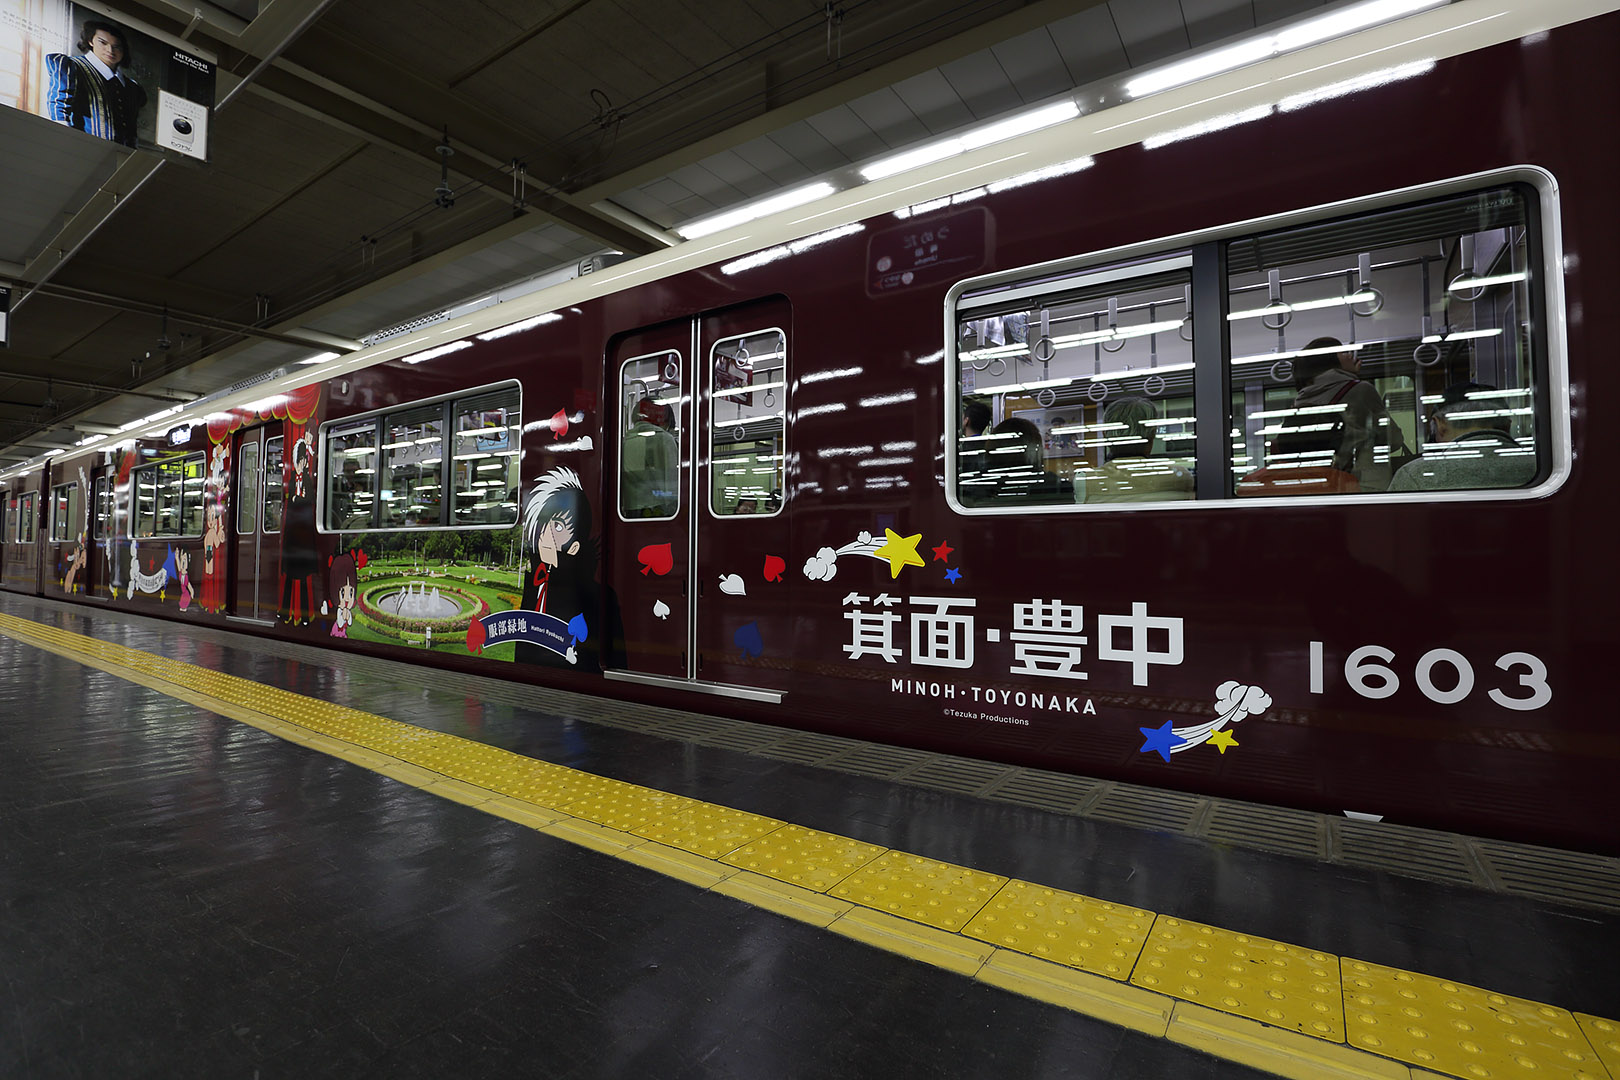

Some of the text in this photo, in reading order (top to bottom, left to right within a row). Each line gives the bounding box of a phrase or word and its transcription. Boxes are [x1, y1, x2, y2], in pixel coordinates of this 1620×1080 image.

[175, 51, 208, 70] HITACHI
[487, 618, 528, 639] 服部緑地
[842, 592, 1184, 687] 箕面・豊中
[1309, 641, 1553, 711] 1603
[980, 712, 1030, 726] Productions
